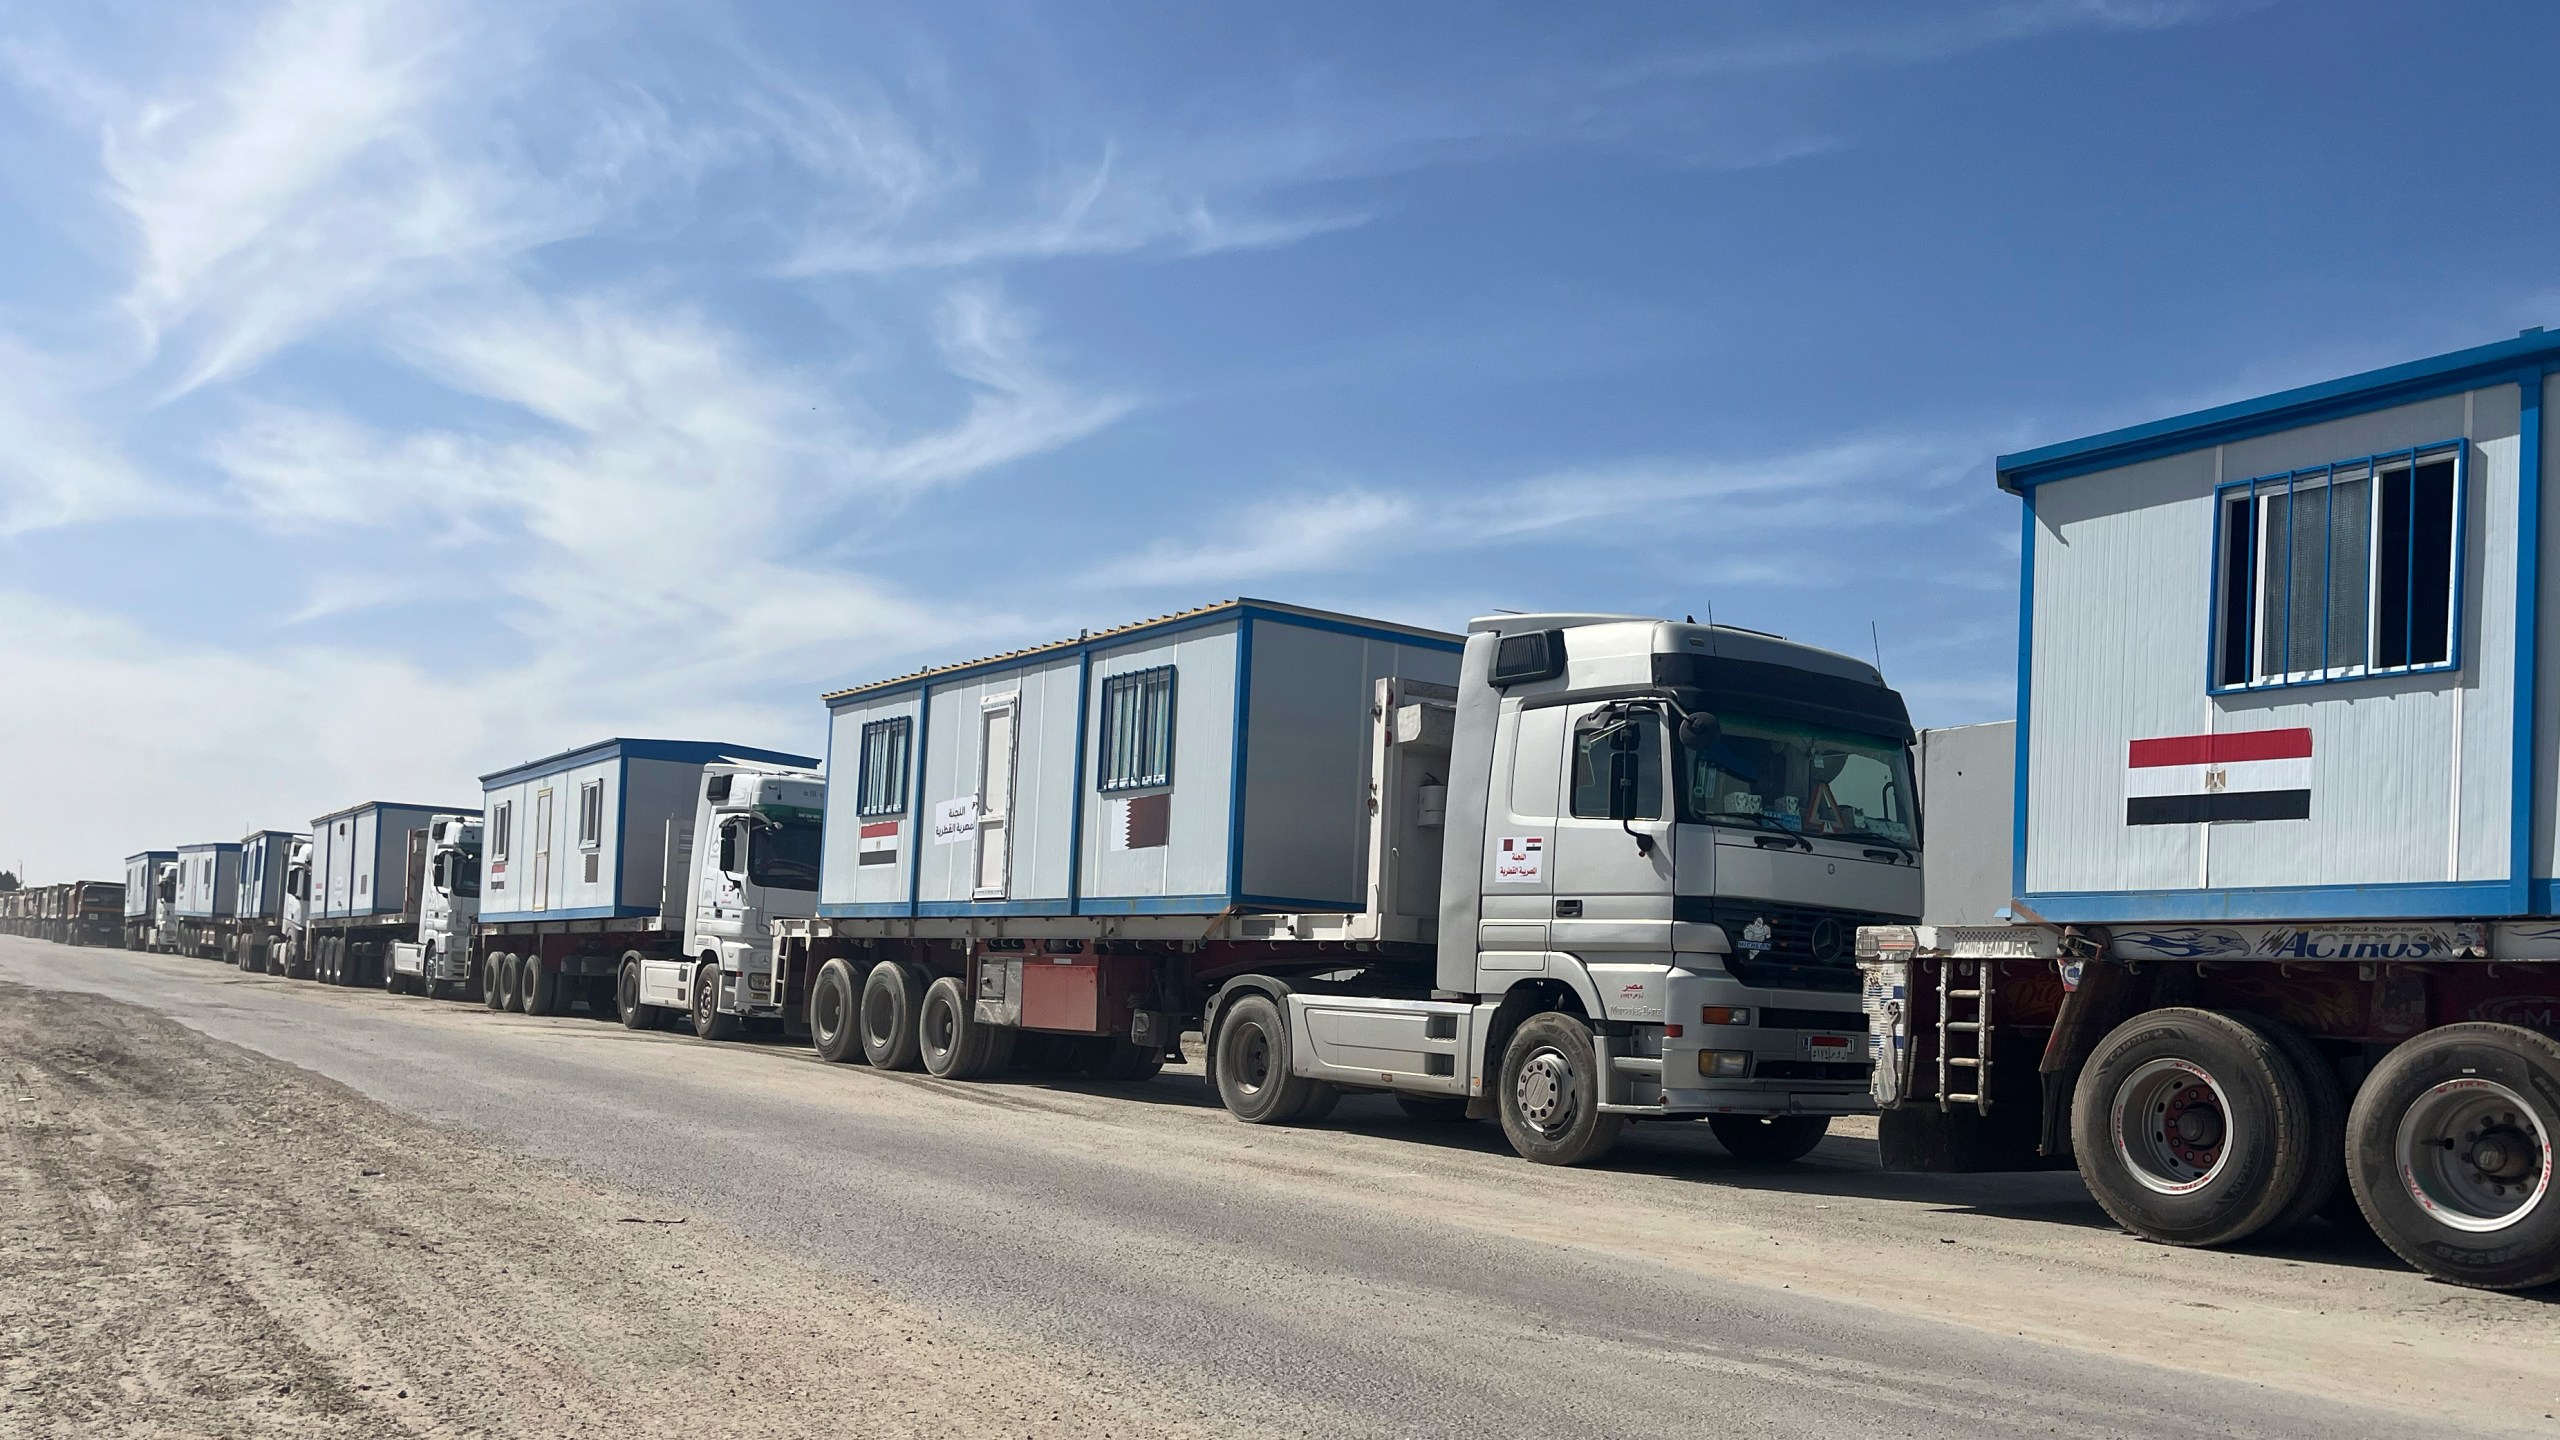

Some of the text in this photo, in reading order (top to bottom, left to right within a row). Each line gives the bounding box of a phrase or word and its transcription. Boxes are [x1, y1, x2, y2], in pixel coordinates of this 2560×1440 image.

[949, 806, 965, 819] اللجنة
[936, 823, 956, 837] القطرية
[1739, 941, 1770, 949] MICHELIN
[1981, 941, 2005, 955] TEAM
[2109, 1032, 2150, 1062] CAM210
